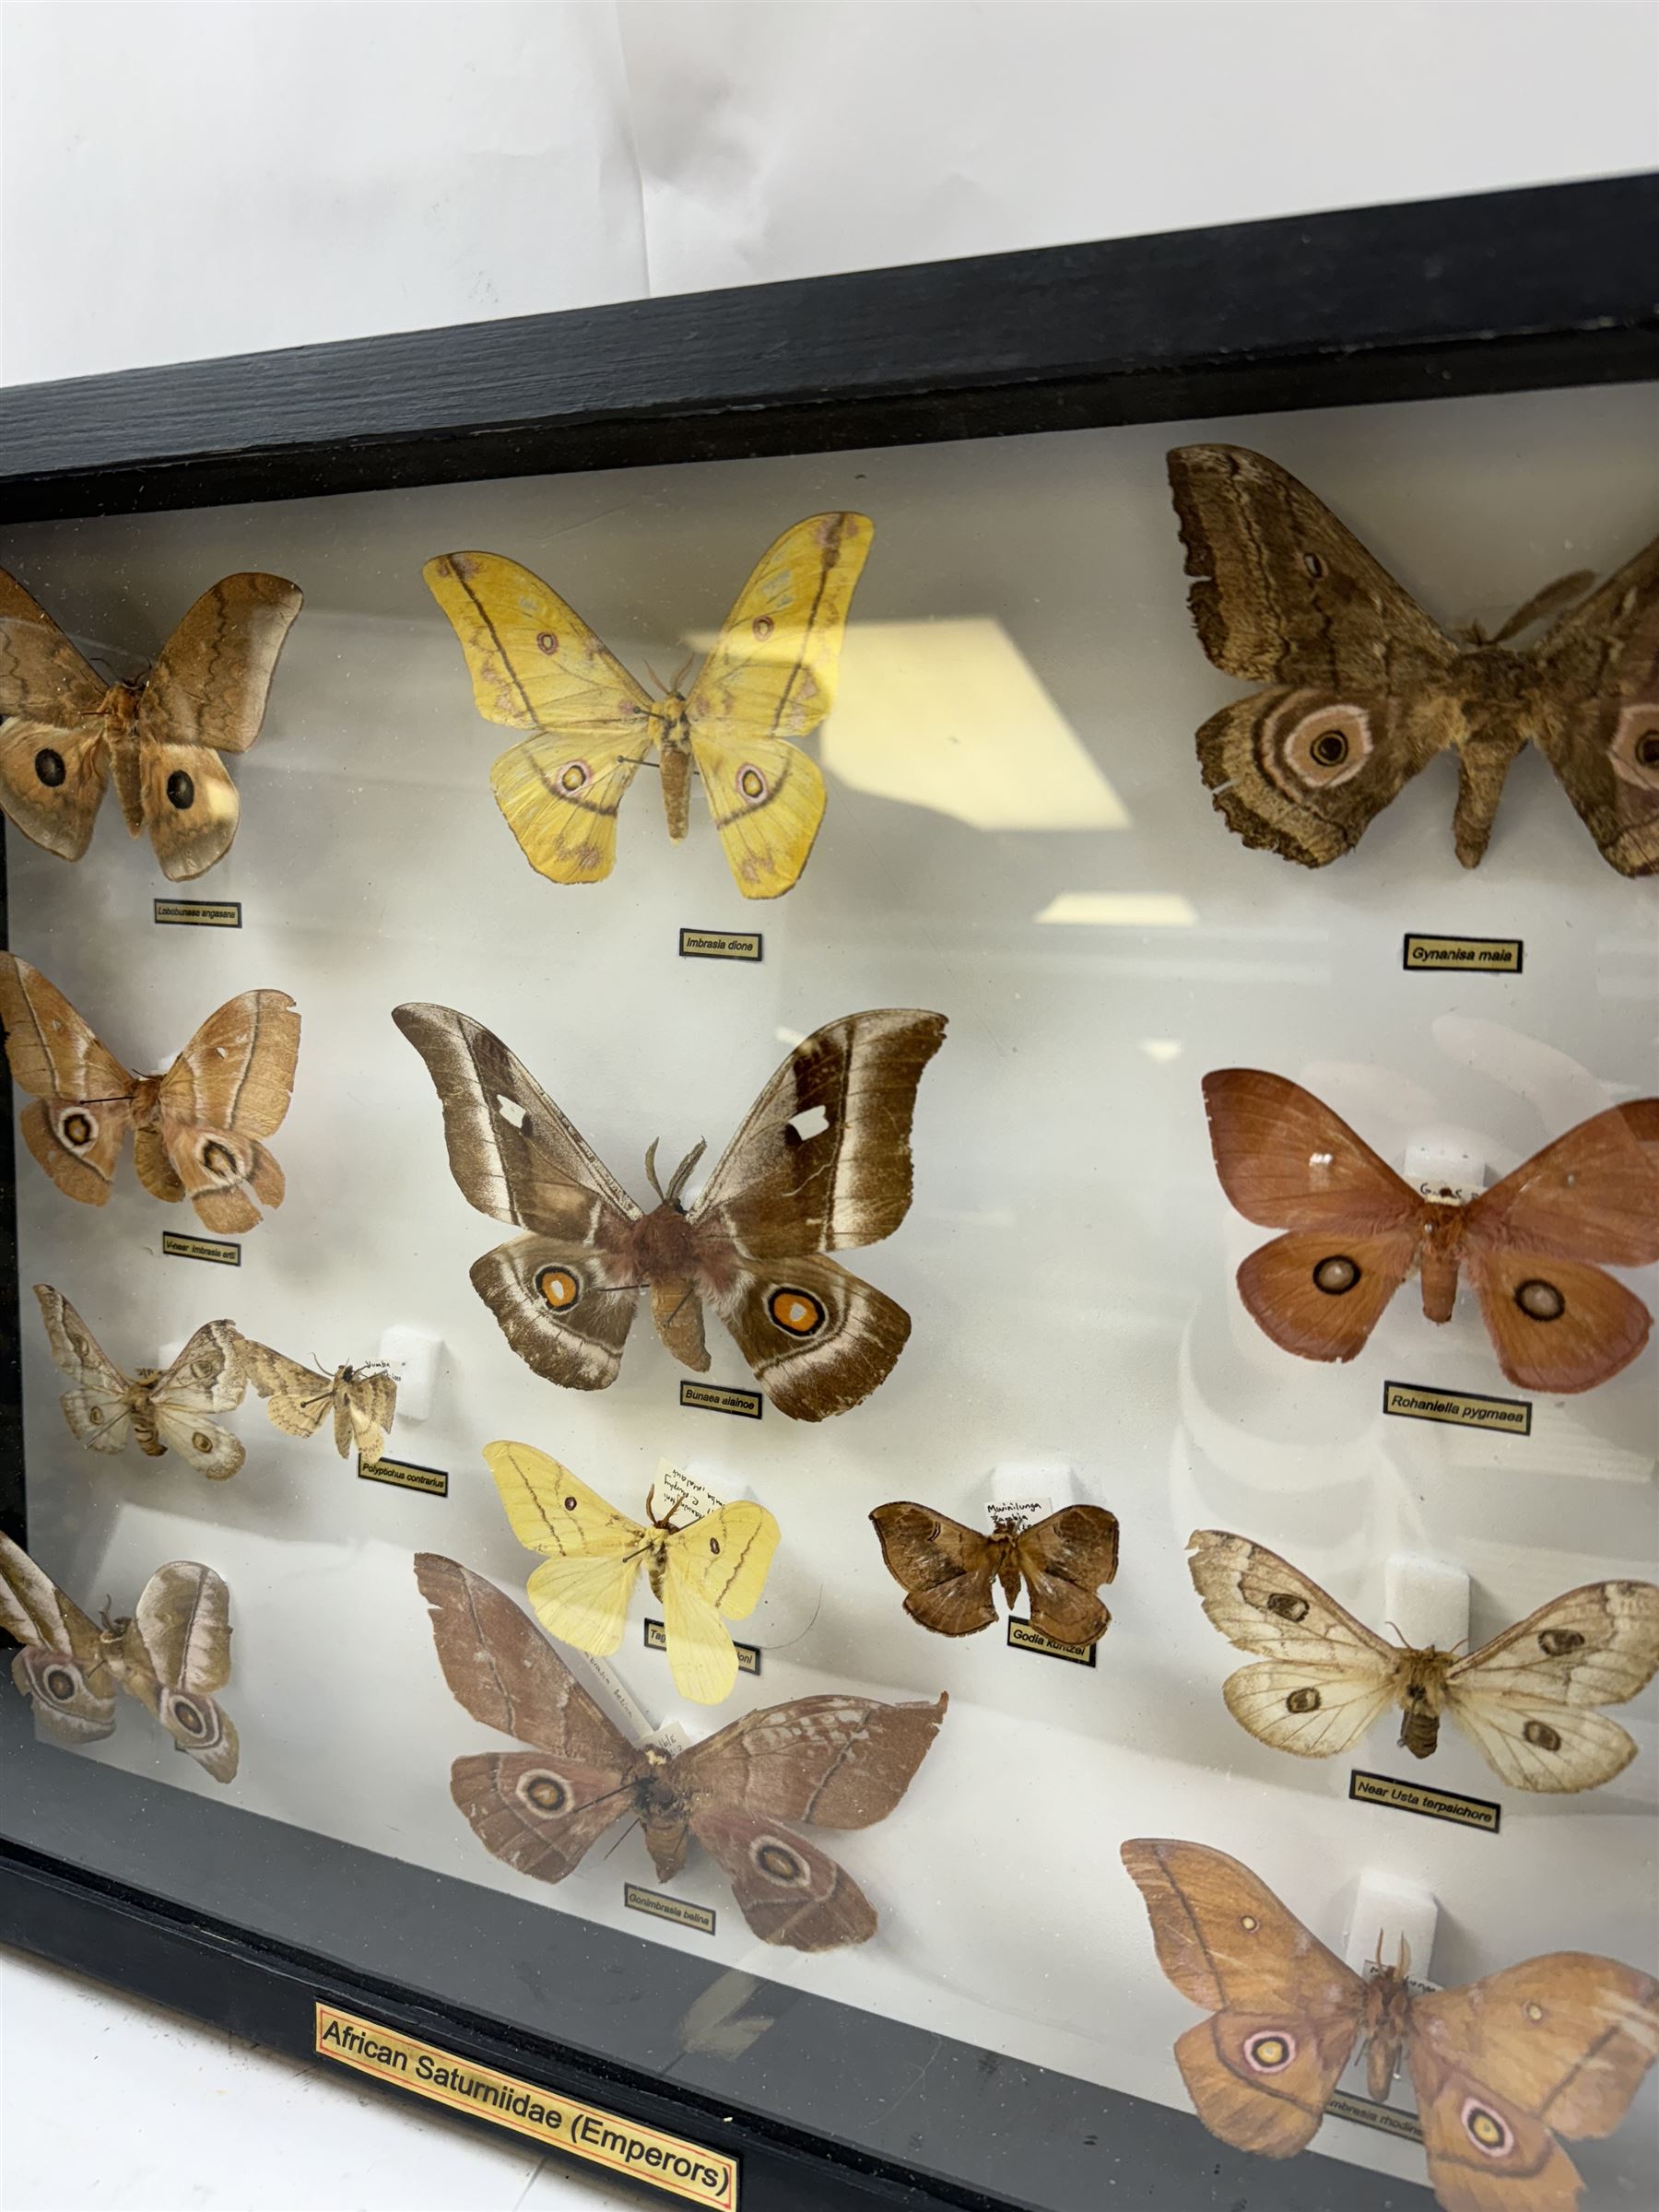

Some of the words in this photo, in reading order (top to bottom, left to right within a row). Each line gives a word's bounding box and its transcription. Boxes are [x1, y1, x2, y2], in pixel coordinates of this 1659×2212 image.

[687, 937, 726, 949] Imbrasia
[728, 940, 753, 951] dione
[1412, 947, 1475, 962] Gynanisa
[1478, 948, 1512, 962] maia
[686, 1389, 720, 1403] Bunaea
[1391, 1394, 1460, 1415] Rohaniella
[1462, 1406, 1524, 1423] pygmaea
[1014, 1630, 1044, 1645] Godia
[1358, 1782, 1389, 1796] Near
[1391, 1788, 1419, 1805] Usta
[1422, 1797, 1492, 1823] terpsichore
[629, 1893, 682, 1916] Gonimbrasia
[322, 2019, 407, 2071] African
[415, 2054, 562, 2130] Saturniidae
[571, 2113, 730, 2198] (Emperors)
